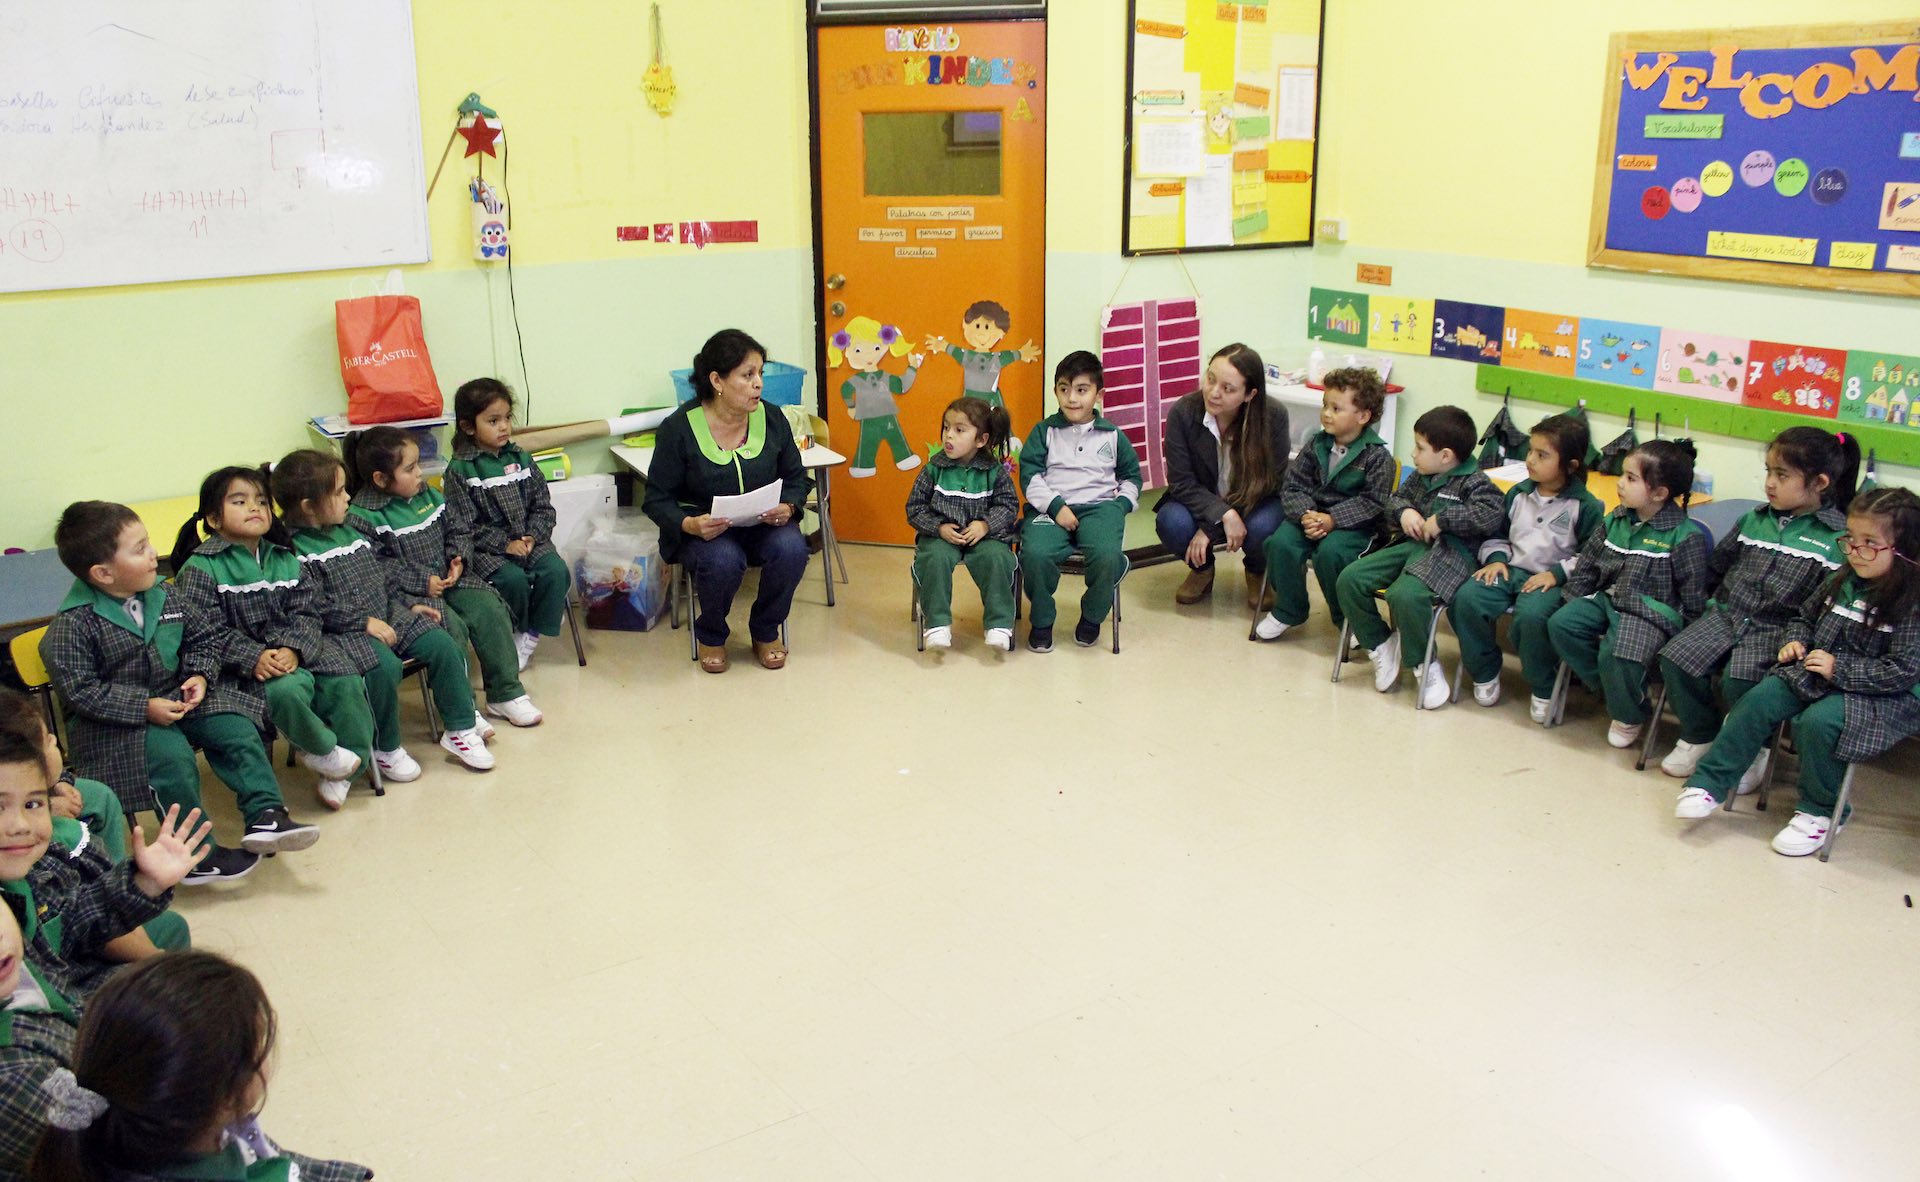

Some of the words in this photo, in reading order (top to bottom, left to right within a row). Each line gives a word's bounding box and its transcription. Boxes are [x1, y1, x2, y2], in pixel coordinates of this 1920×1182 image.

[1621, 45, 1920, 119] WELCOM
[1010, 97, 1034, 121] A
[1654, 121, 1717, 136] Vocabulary
[1744, 158, 1773, 175] purple
[1777, 170, 1805, 183] green
[1675, 185, 1697, 197] pink
[1817, 176, 1844, 191] blue
[890, 208, 926, 219] Palabras
[929, 210, 944, 218] con
[947, 209, 973, 221] poder
[862, 227, 875, 238] Por
[879, 230, 904, 241] favor
[918, 229, 953, 240] permiso
[968, 229, 999, 240] gracias
[896, 246, 935, 258] disculpa
[1739, 239, 1761, 257] day
[1836, 246, 1869, 267] day
[1310, 304, 1318, 324] 1
[1373, 312, 1382, 332] 2
[1434, 318, 1445, 339] 3
[1505, 327, 1517, 349] 4
[343, 348, 418, 370] FABER-CASTELL
[1580, 338, 1592, 360] 5
[1661, 349, 1672, 372] 6
[1749, 361, 1765, 385] 7
[1845, 376, 1861, 400] 8
